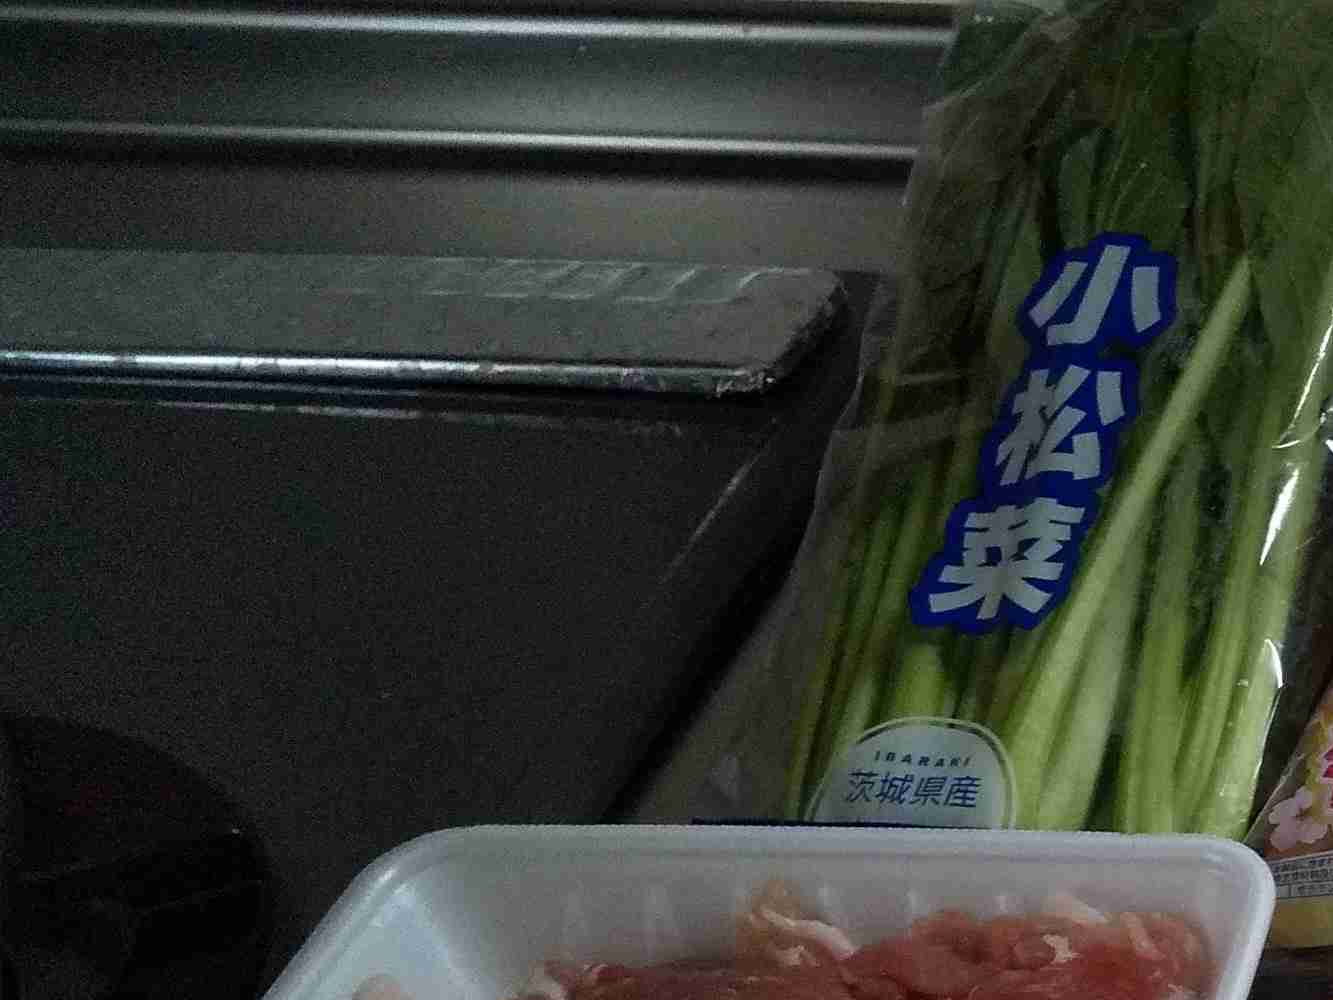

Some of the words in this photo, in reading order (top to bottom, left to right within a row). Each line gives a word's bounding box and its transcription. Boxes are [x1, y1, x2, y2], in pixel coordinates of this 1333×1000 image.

[924, 242, 1166, 624] 小松菜
[874, 751, 972, 767] IBARAKI
[843, 771, 982, 808] 茨城県産
